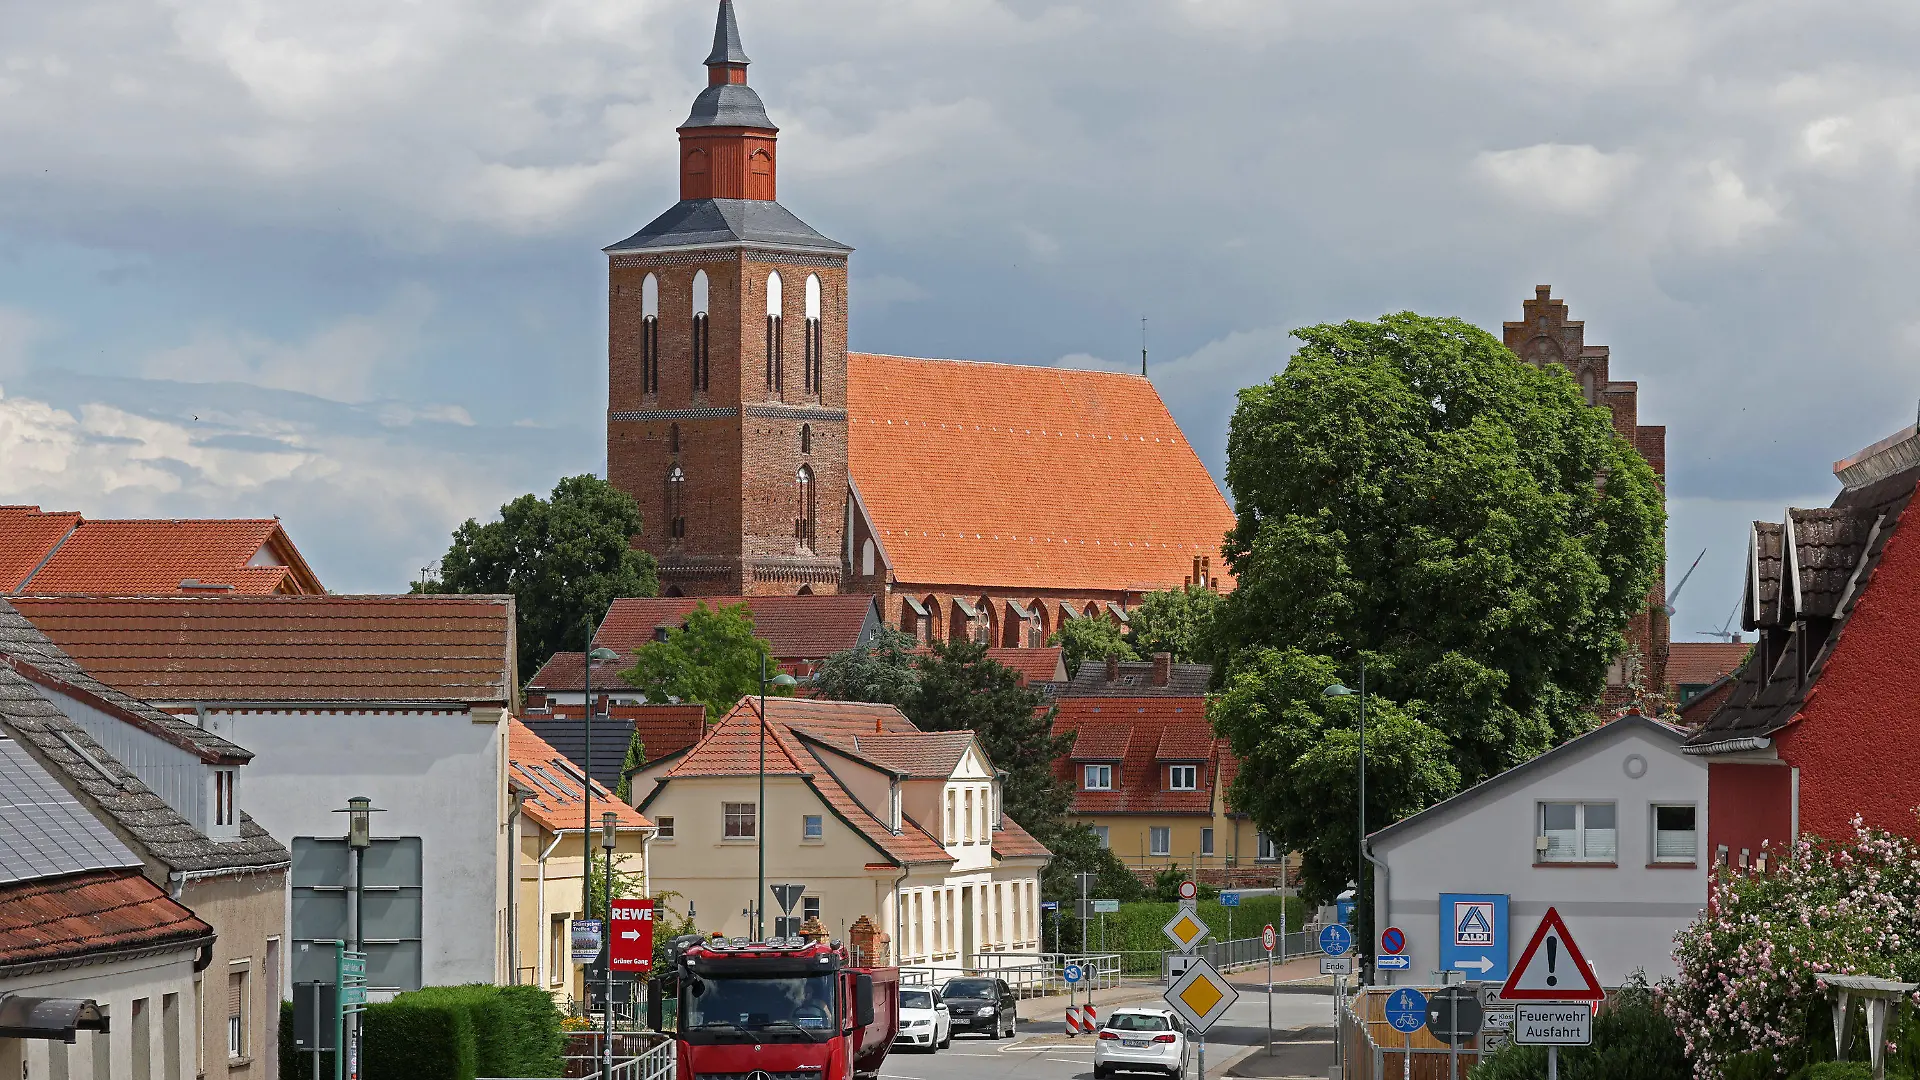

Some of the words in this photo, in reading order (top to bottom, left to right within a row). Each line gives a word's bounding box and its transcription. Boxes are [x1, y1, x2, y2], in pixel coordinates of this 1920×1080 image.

[611, 908, 653, 920] REWE
[1461, 933, 1488, 941] ALDI
[634, 958, 649, 966] Gang
[1519, 1010, 1586, 1022] Feuerwehr
[1525, 1026, 1581, 1038] Ausfahrt
